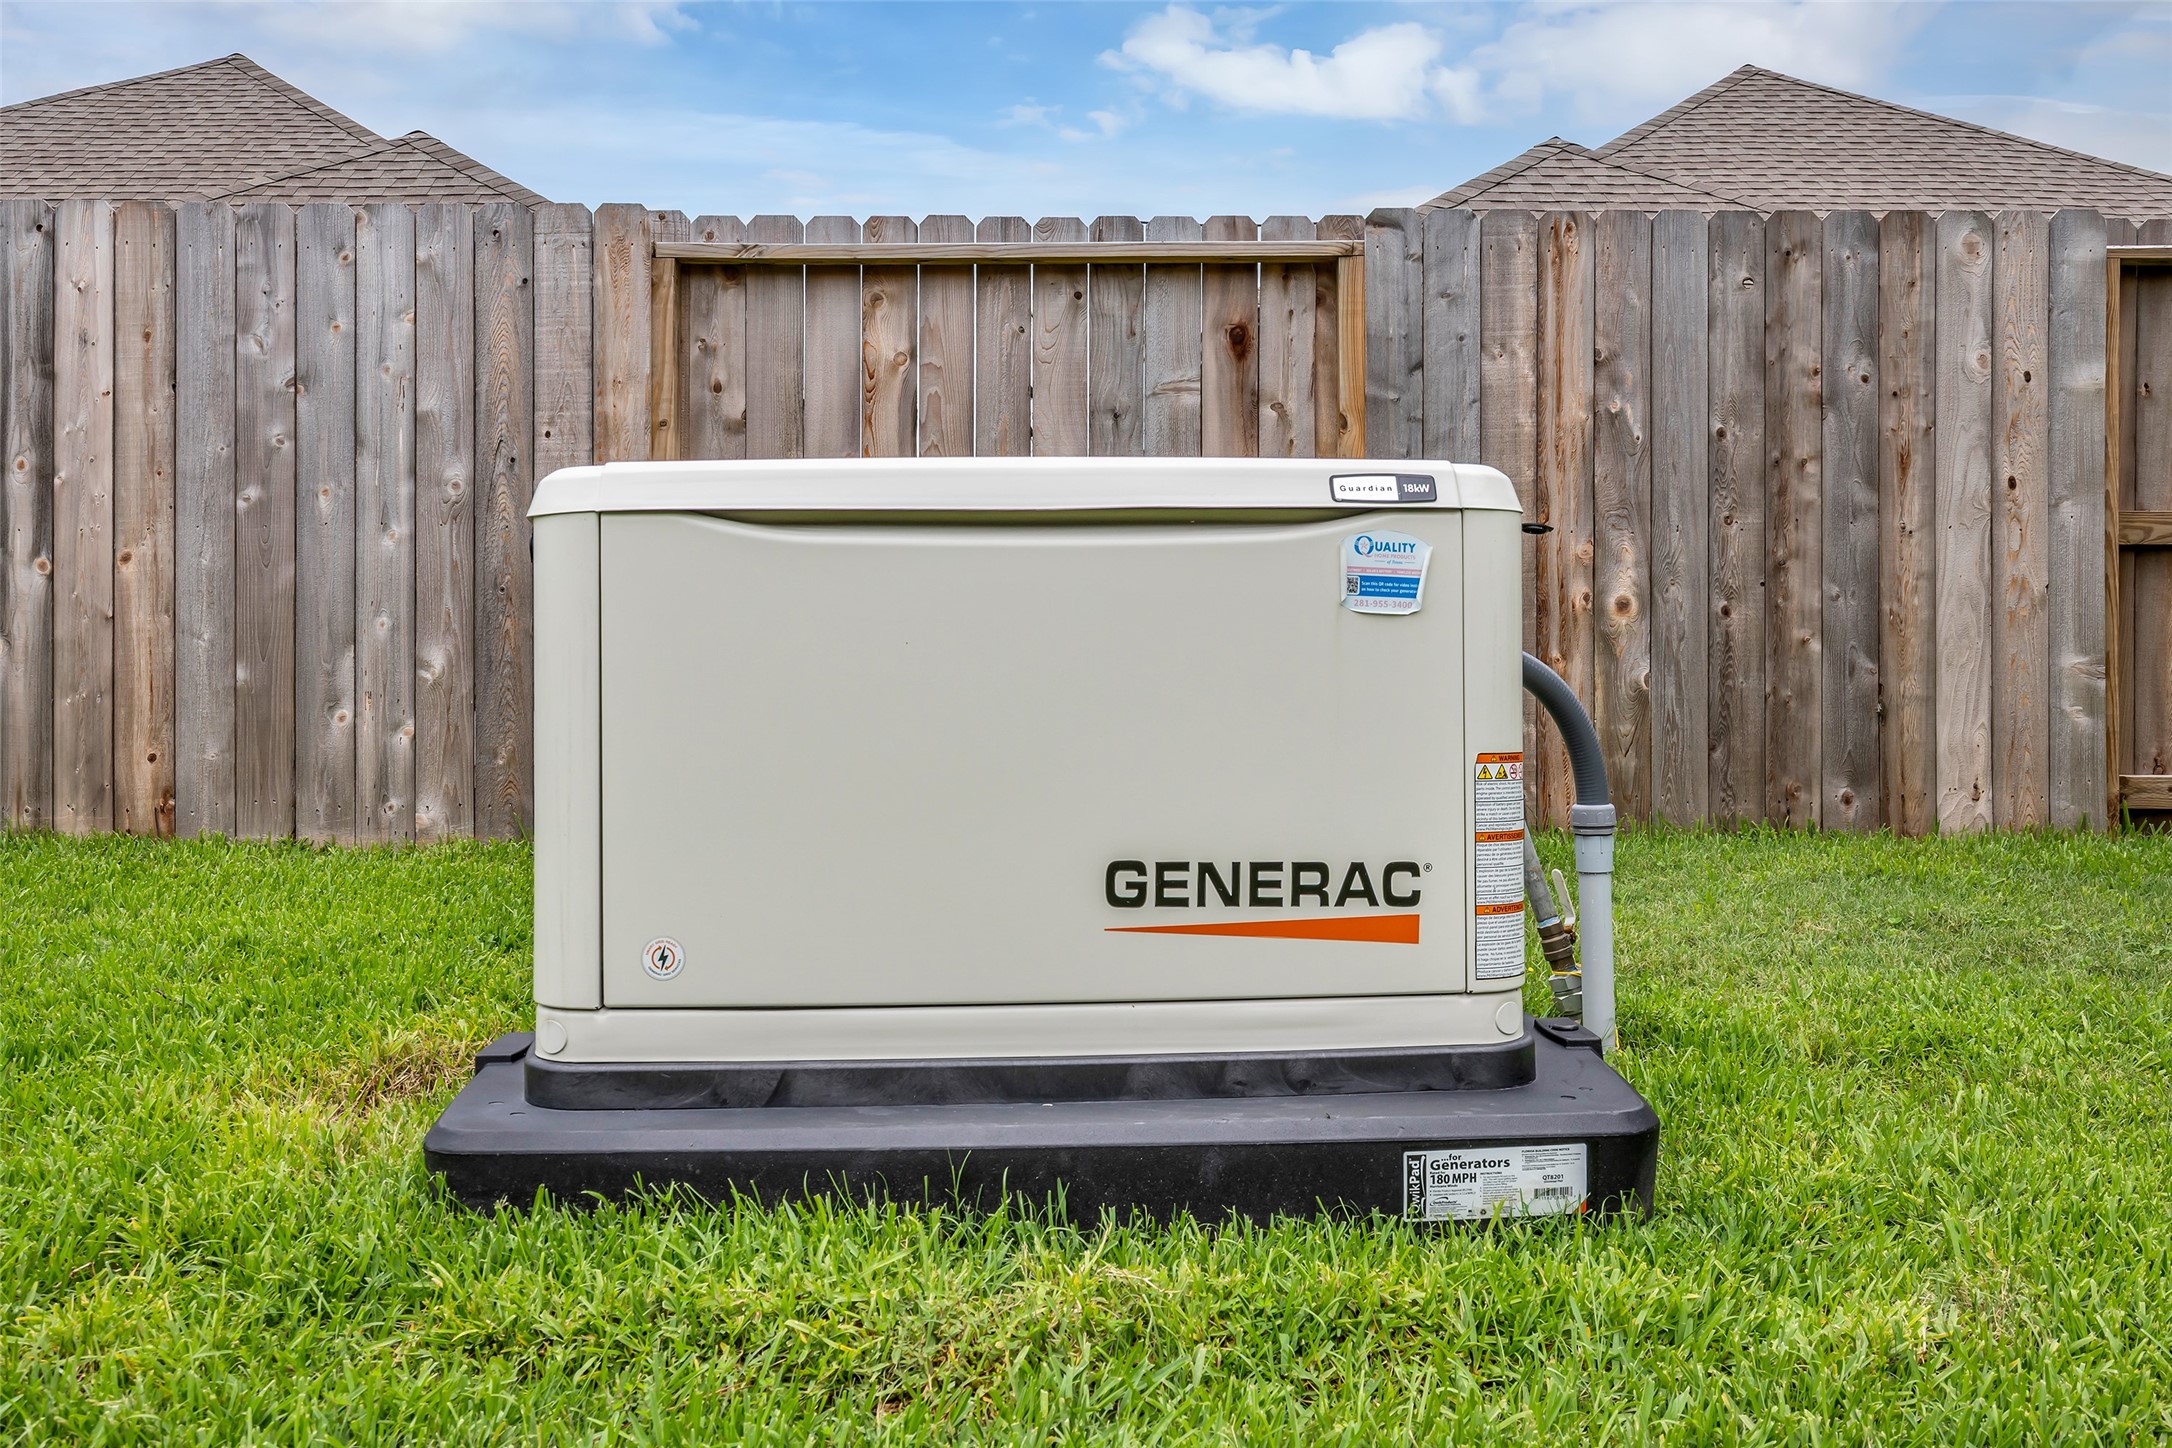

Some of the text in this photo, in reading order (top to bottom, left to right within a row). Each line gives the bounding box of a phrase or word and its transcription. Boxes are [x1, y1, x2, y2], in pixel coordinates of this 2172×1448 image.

[1339, 484, 1430, 493] Guardian 18kW
[1354, 536, 1416, 558] QUALITY
[1354, 600, 1413, 609] 281-955-3400
[1105, 860, 1422, 908] GENERAC
[1430, 1158, 1510, 1170] Generators
[1430, 1172, 1477, 1185] 180 MPH
[1409, 1160, 1420, 1214] QwikPad
